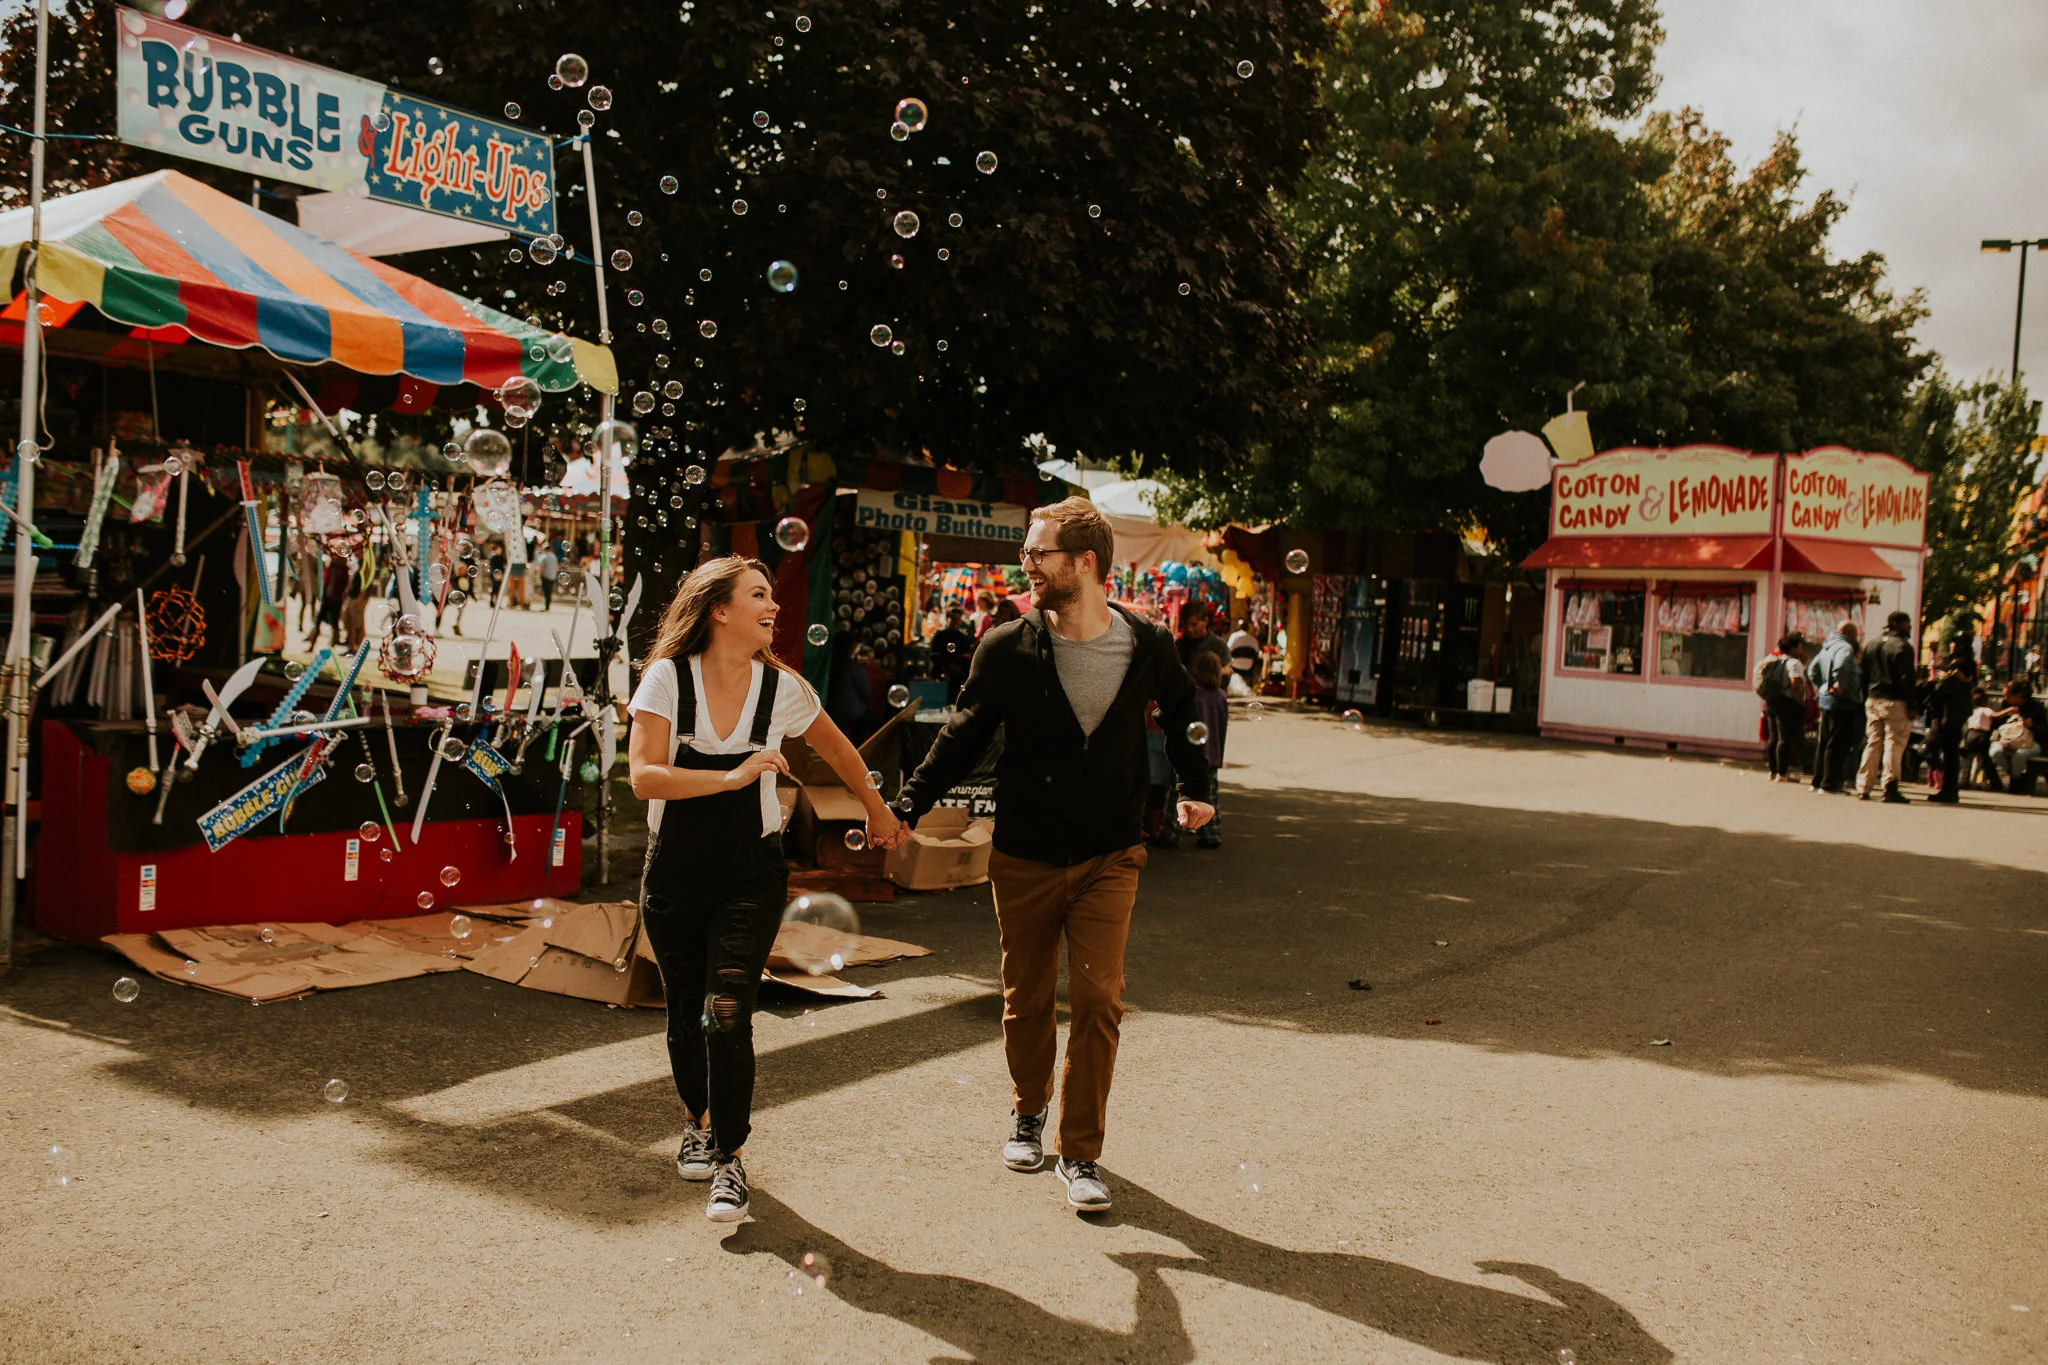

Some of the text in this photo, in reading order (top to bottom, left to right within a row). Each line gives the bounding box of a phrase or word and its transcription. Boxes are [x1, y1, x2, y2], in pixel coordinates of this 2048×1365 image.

[142, 40, 341, 153] BUBBLE
[178, 114, 314, 171] GUNS
[358, 112, 548, 222] & Light-Ups
[1558, 473, 1641, 499] COTTON
[1639, 474, 1768, 525] & LEMONADE
[1790, 469, 1848, 499] COTTON
[858, 506, 1025, 541] Photo Buttons
[893, 492, 993, 518] Giant
[1559, 504, 1630, 529] CANDY
[1791, 506, 1841, 531] CANDY
[1844, 483, 1923, 530] & LEMONADE
[211, 788, 273, 839] BUBBLE
